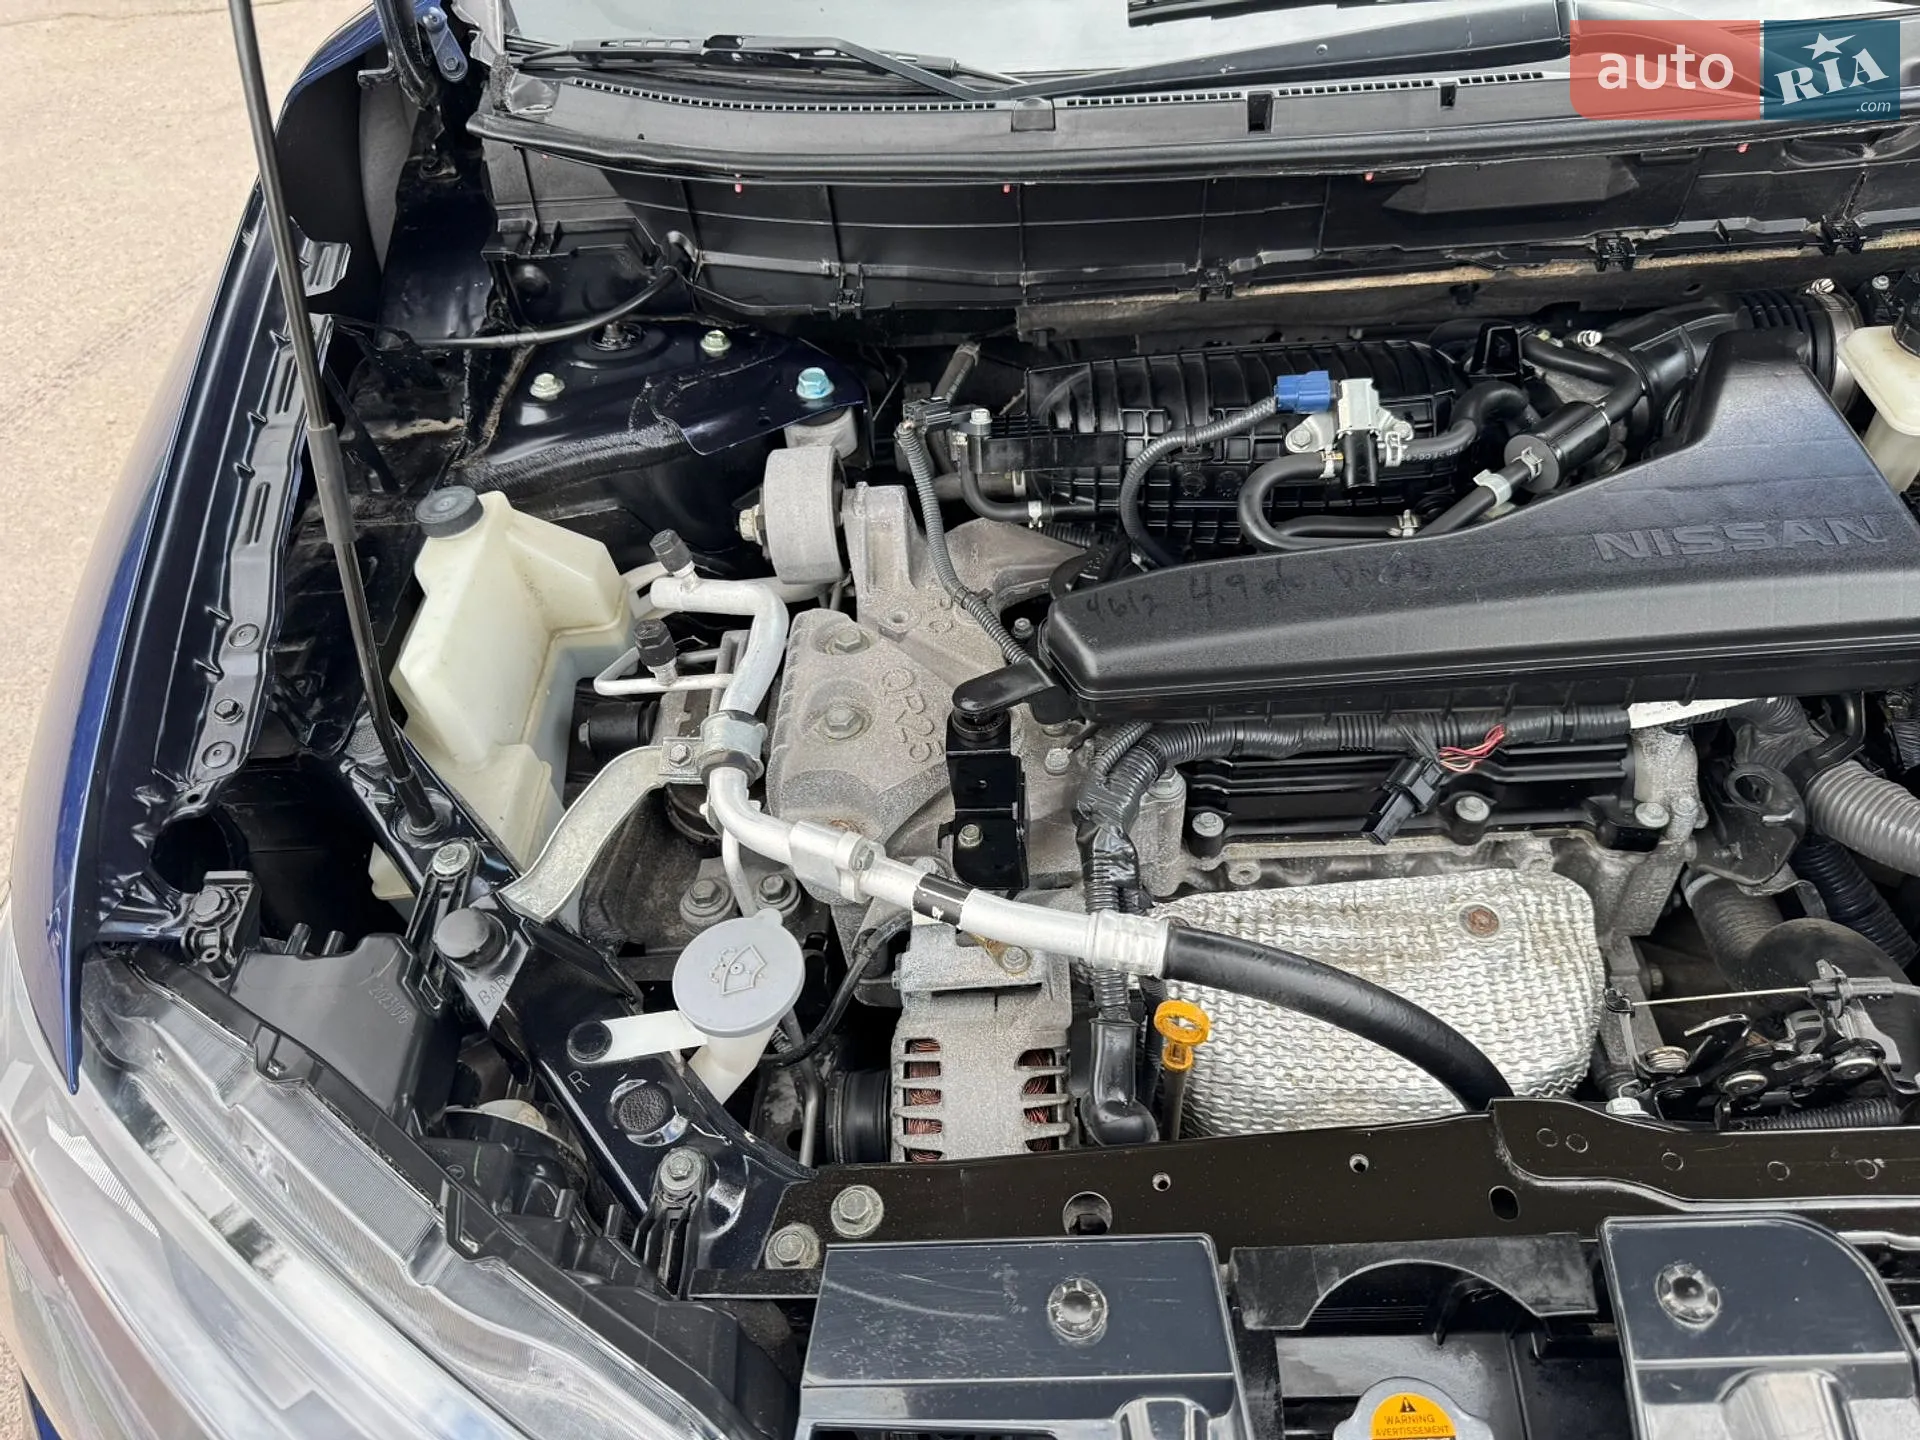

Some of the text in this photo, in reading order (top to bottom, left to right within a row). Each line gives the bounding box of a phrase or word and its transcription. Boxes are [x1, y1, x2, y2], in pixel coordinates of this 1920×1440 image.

[1591, 514, 1888, 562] NISSAN
[881, 667, 945, 763] QR25
[477, 974, 510, 1006] BAR
[567, 1070, 591, 1094] R
[1375, 1425, 1449, 1437] AVERTISSEMENT
[1384, 1414, 1435, 1425] WARNING
